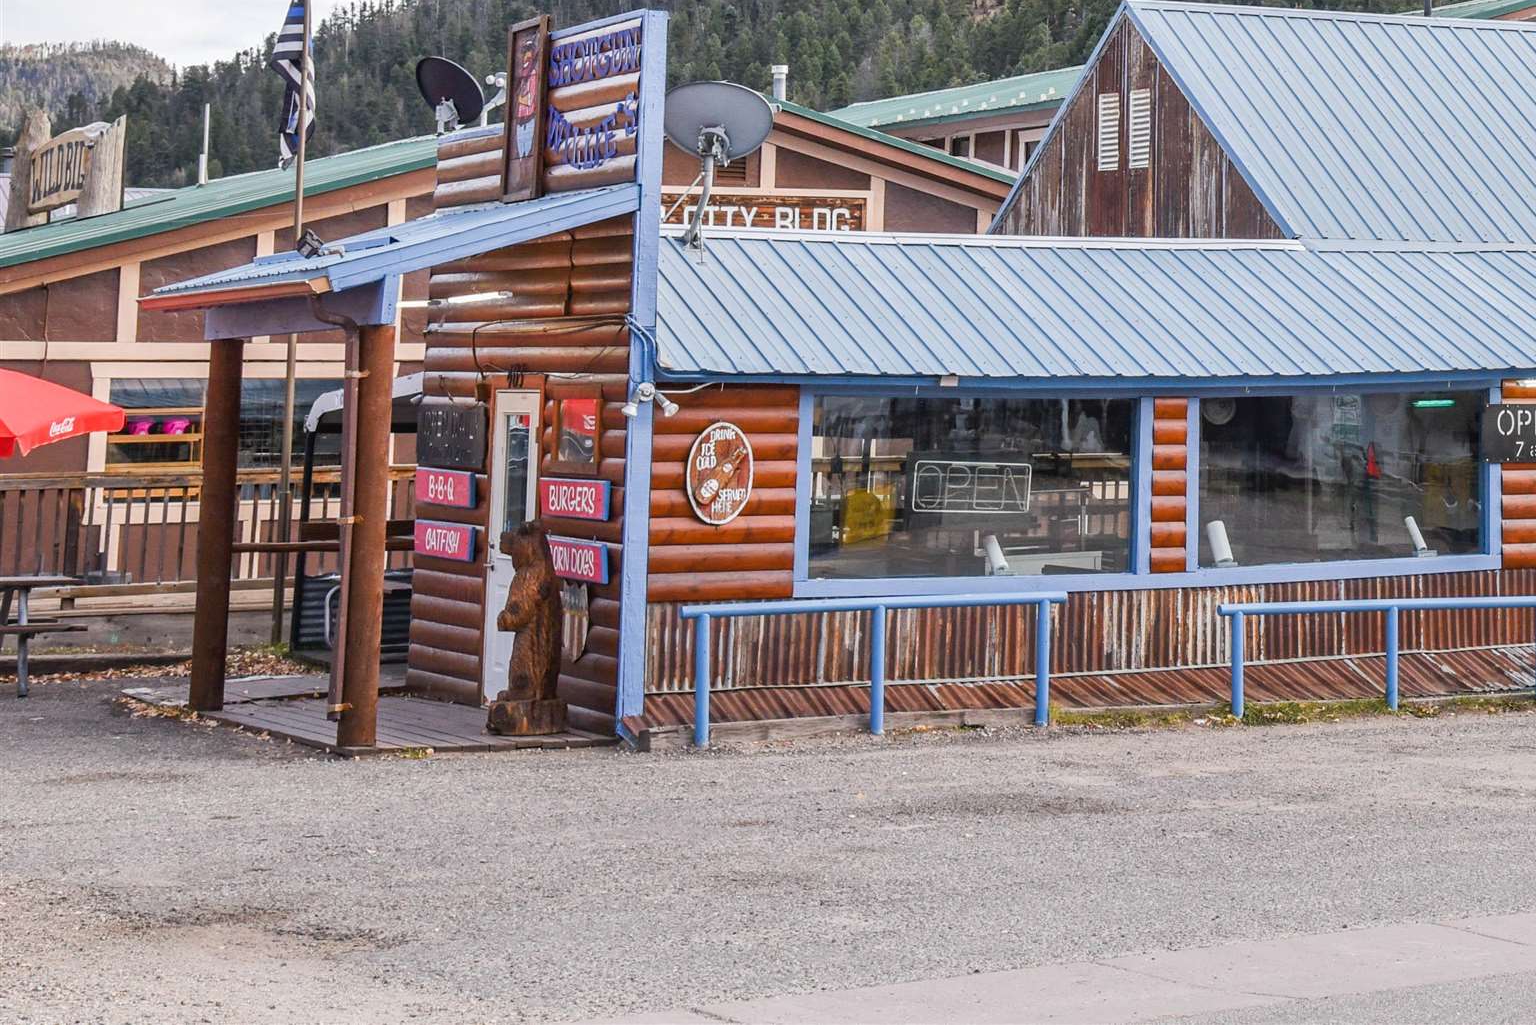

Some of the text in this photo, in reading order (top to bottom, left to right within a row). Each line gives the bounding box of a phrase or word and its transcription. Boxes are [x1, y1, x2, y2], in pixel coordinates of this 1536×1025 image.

[549, 26, 642, 87] SHOTGUN
[547, 90, 638, 171] WILLIE'S
[32, 143, 64, 205] WILD
[701, 442, 716, 457] ICE
[710, 428, 736, 443] DRINK
[1515, 441, 1525, 457] 7
[548, 483, 597, 515] BURGERS
[915, 464, 1030, 512] OPEN
[424, 527, 461, 555] CATFISH
[570, 547, 596, 578] DOGS
